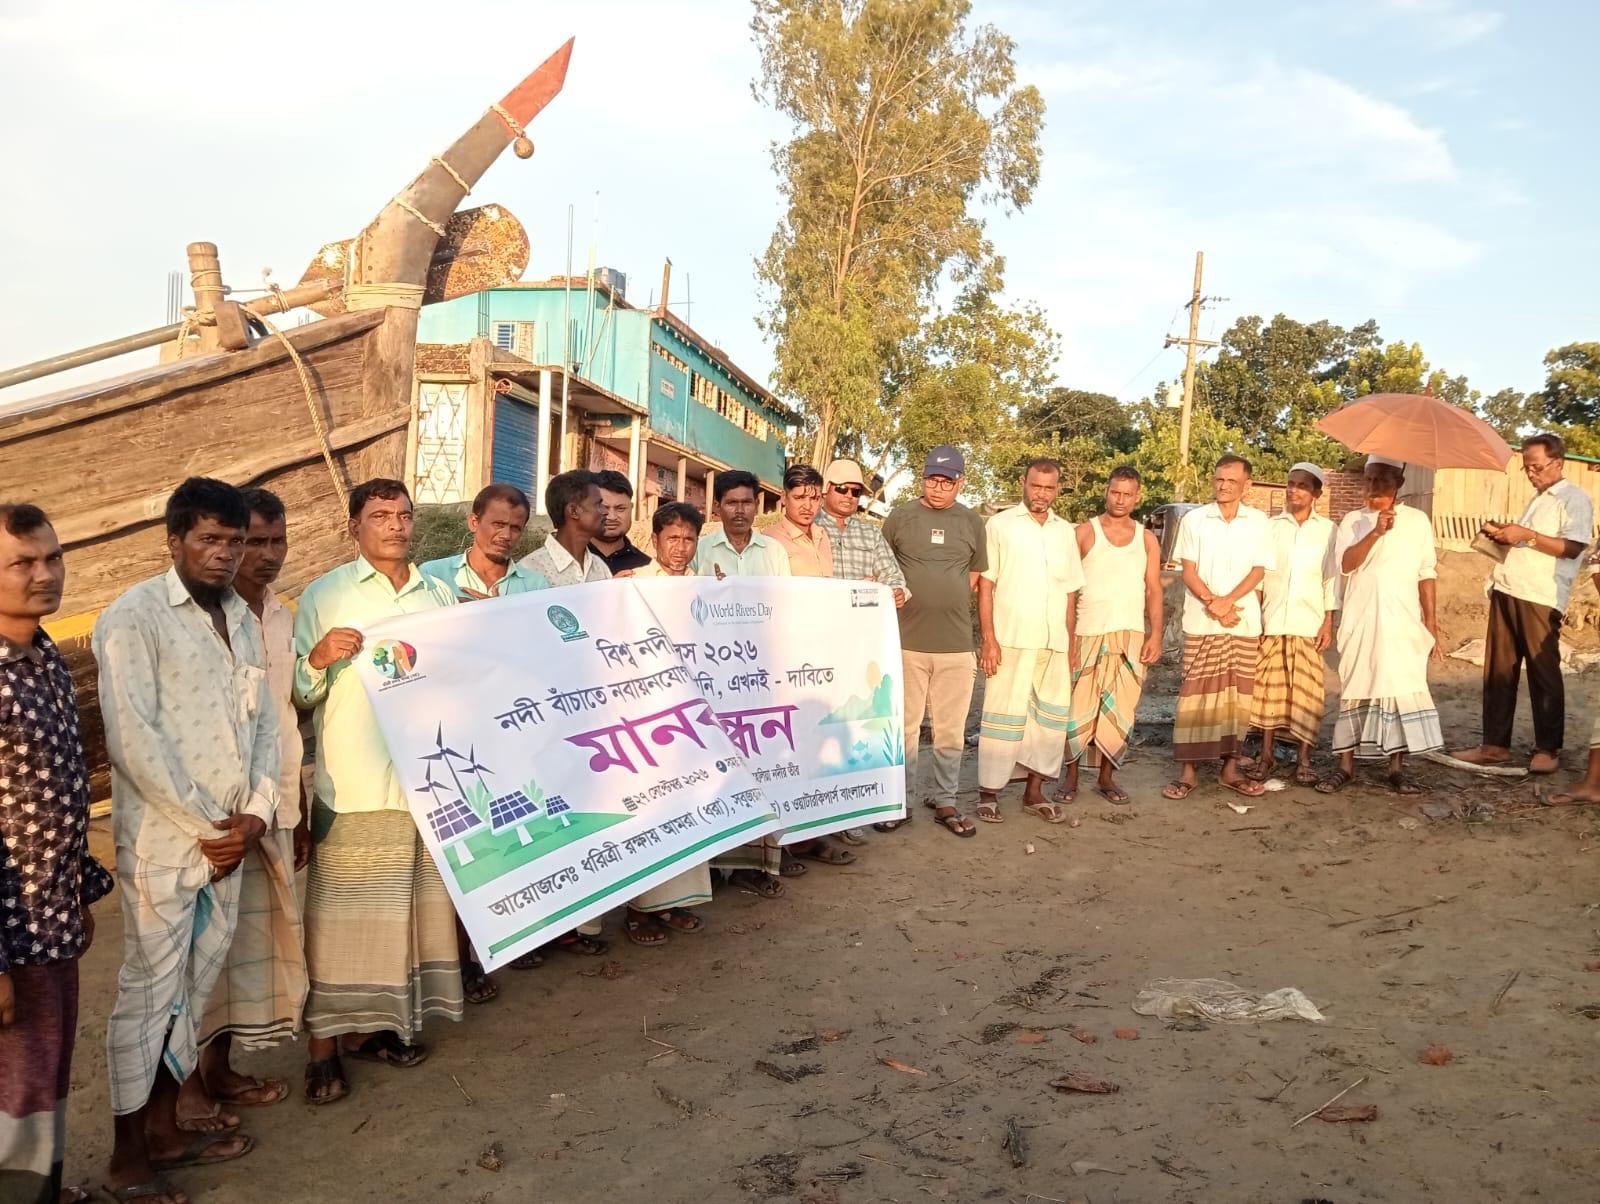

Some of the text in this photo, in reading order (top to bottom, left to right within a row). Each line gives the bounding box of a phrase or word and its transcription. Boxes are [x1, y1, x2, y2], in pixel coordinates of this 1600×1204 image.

[709, 602, 773, 620] World Rivers Day
[596, 638, 639, 668] বিশ্ব
[703, 640, 758, 666] ২০২৬
[494, 697, 545, 732] নদী
[545, 687, 607, 716] বাঁচাতে
[728, 666, 771, 693] এখনই
[786, 663, 834, 689] দাবিতে
[681, 769, 710, 786] ২০২৬
[581, 840, 623, 875] ধরিত্রী
[658, 811, 699, 837] আমরা
